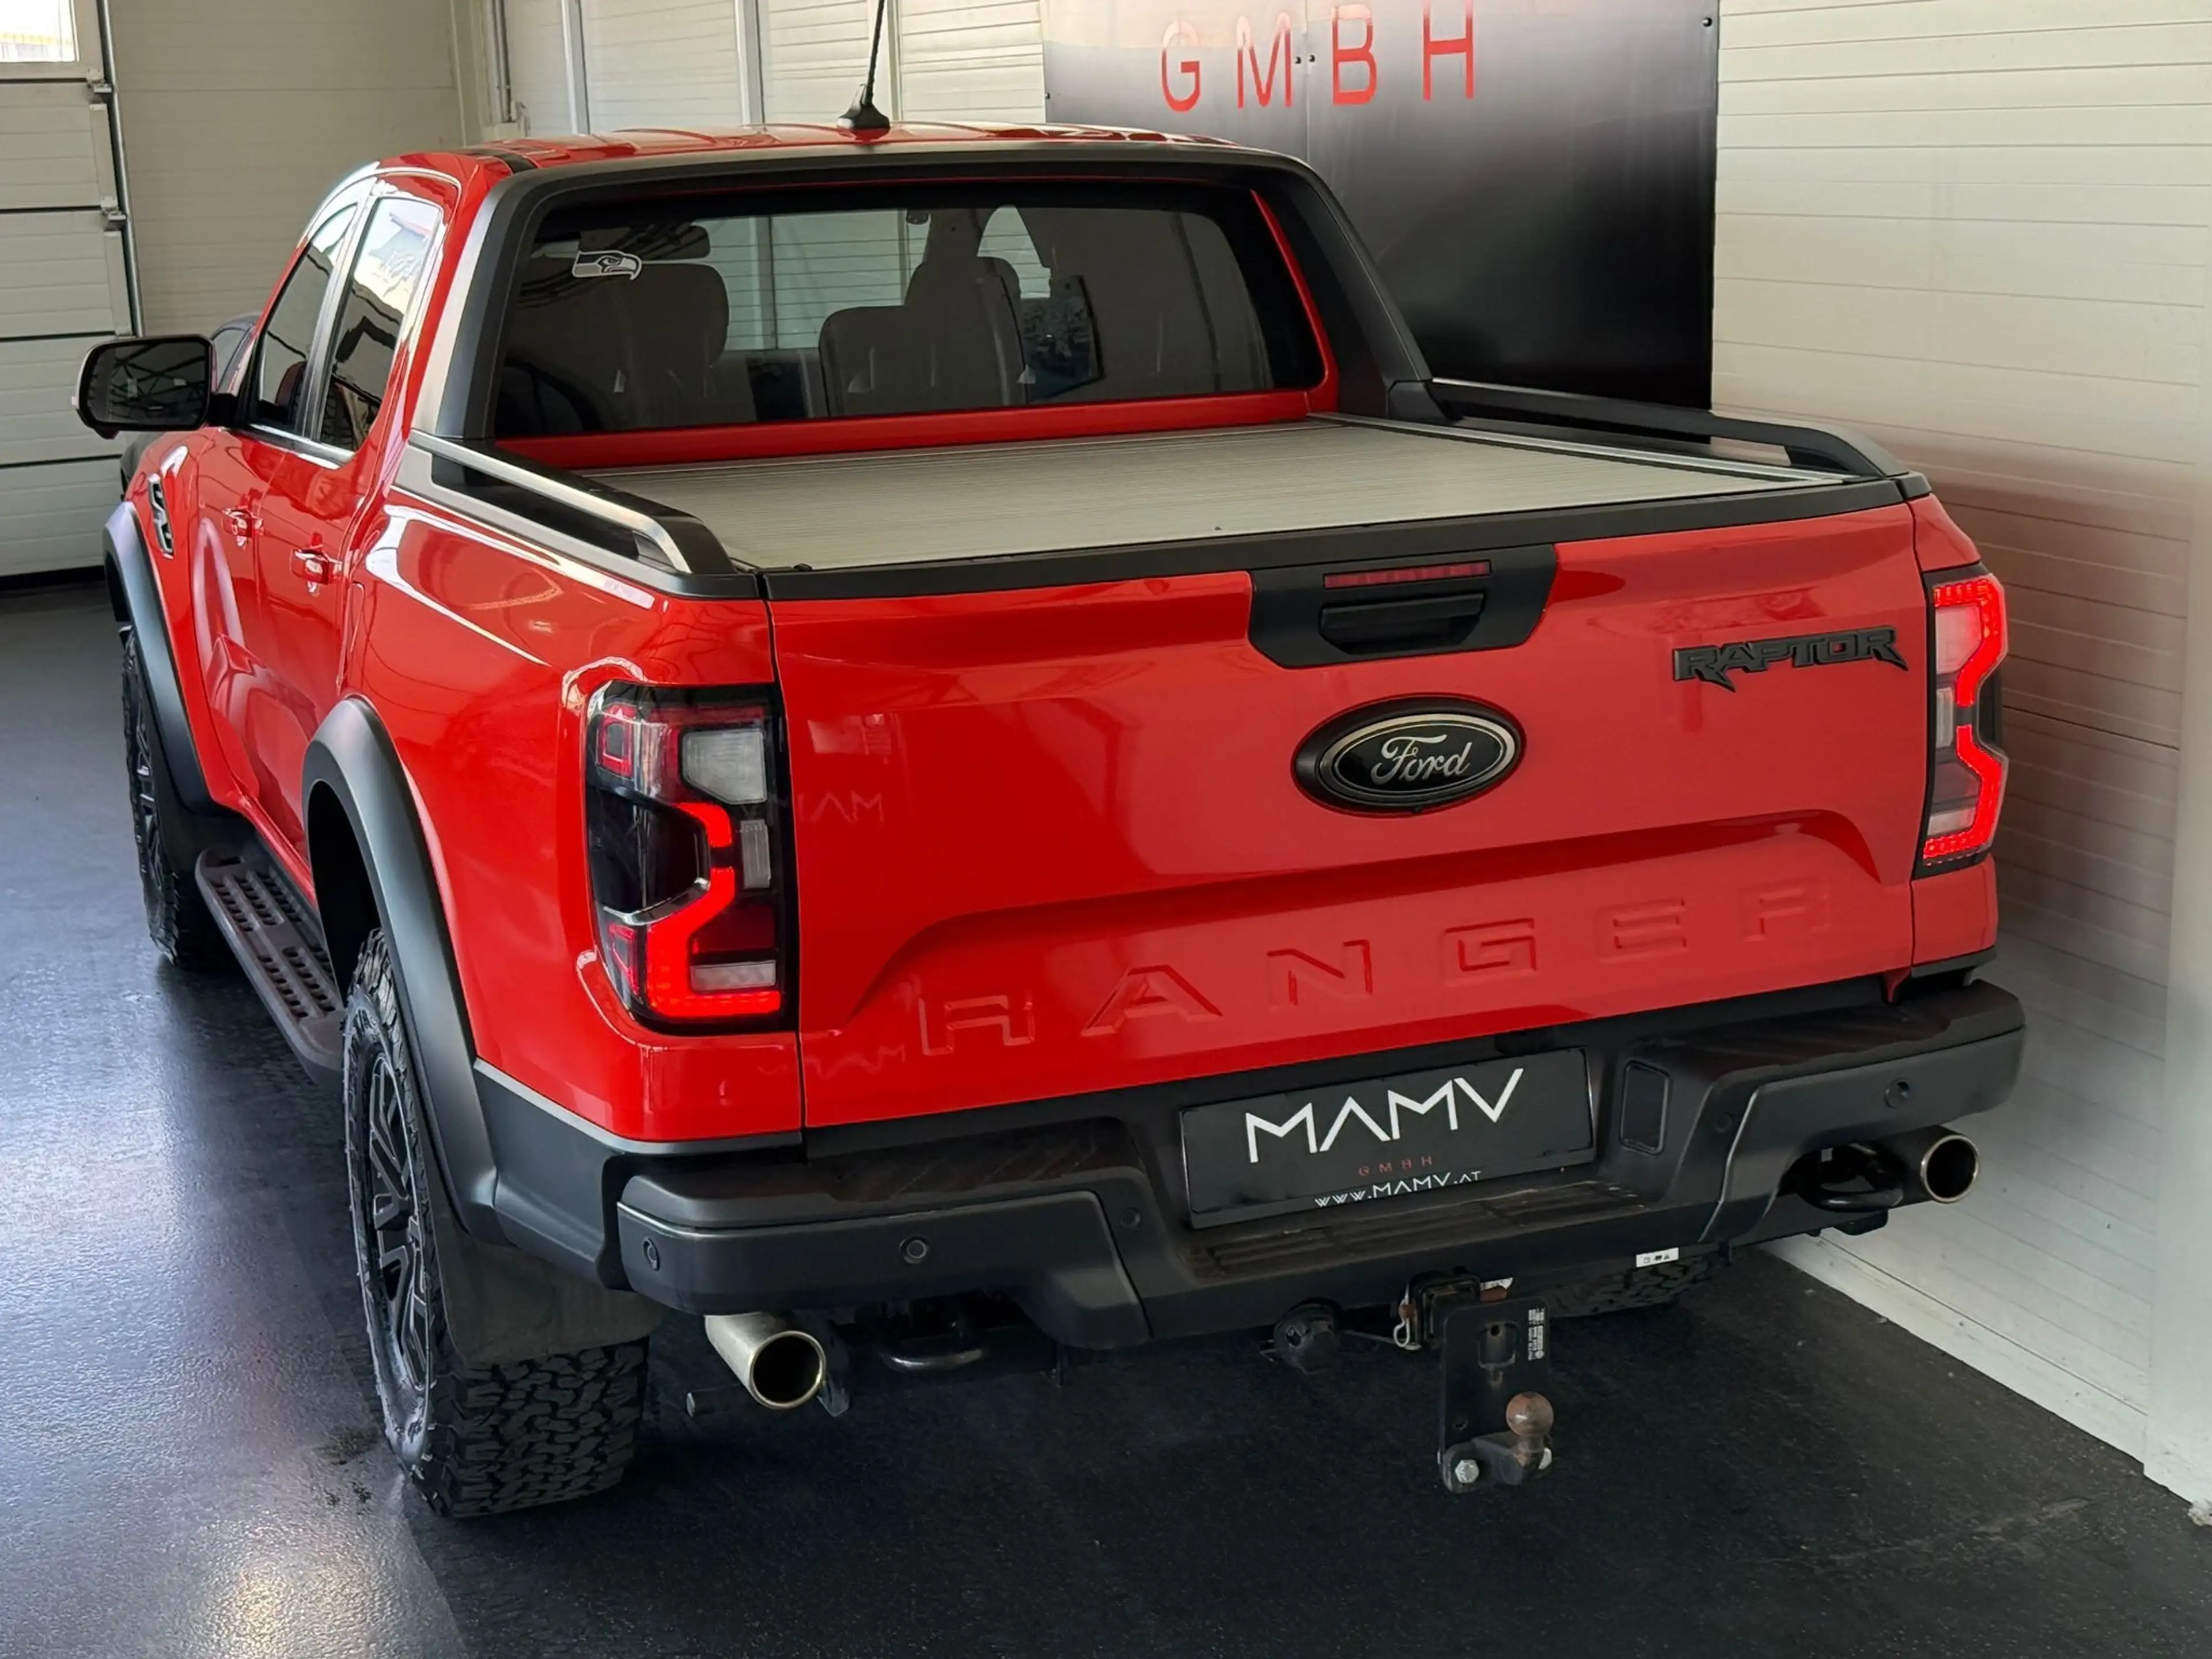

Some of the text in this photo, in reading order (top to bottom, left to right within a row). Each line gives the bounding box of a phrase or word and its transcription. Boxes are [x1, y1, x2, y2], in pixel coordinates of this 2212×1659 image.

[1672, 625, 1909, 693] RAPTOR
[1370, 733, 1473, 786] Ford
[918, 877, 1832, 1058] RANGER
[1244, 1067, 1525, 1164] MAMV
